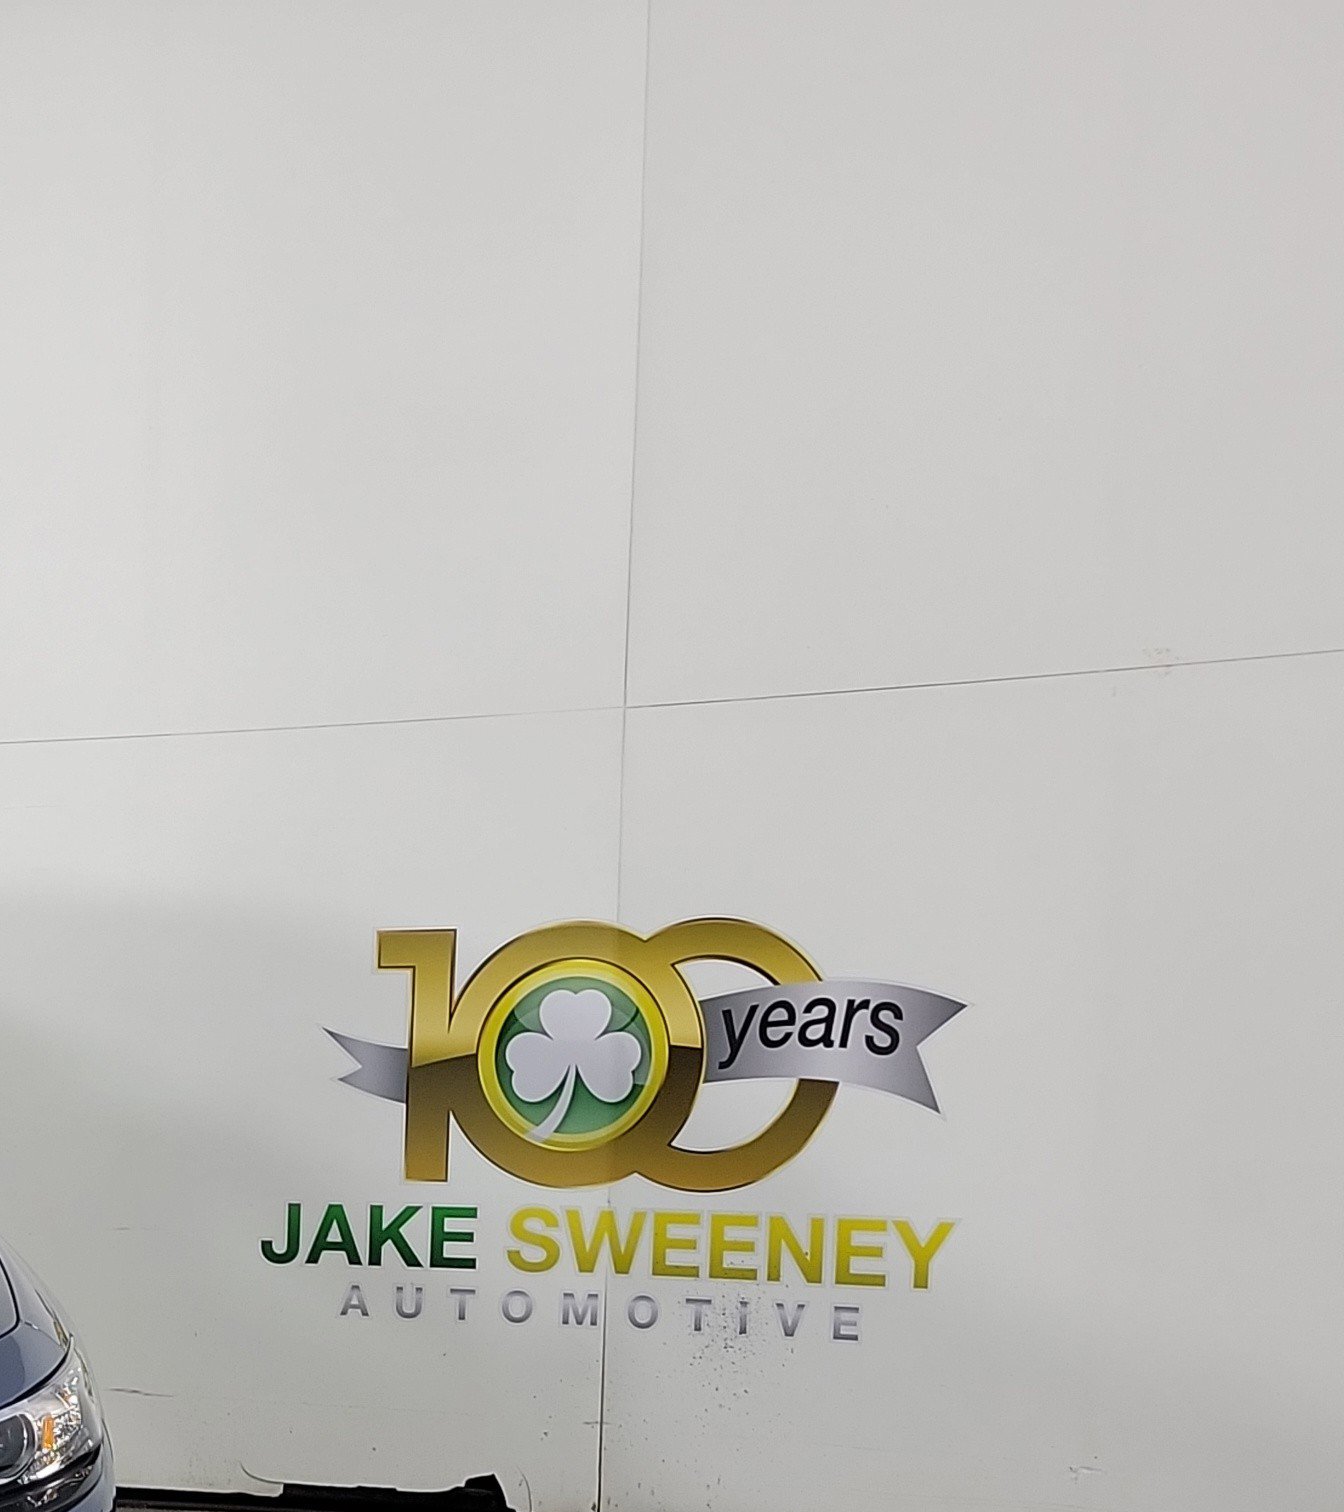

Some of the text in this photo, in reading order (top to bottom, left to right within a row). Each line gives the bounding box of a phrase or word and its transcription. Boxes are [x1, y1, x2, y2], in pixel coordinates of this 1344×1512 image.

[375, 916, 905, 1193] 100 years
[260, 1203, 956, 1290] JAKE SWEENEY
[339, 1284, 861, 1342] AUTOMOTIVE
